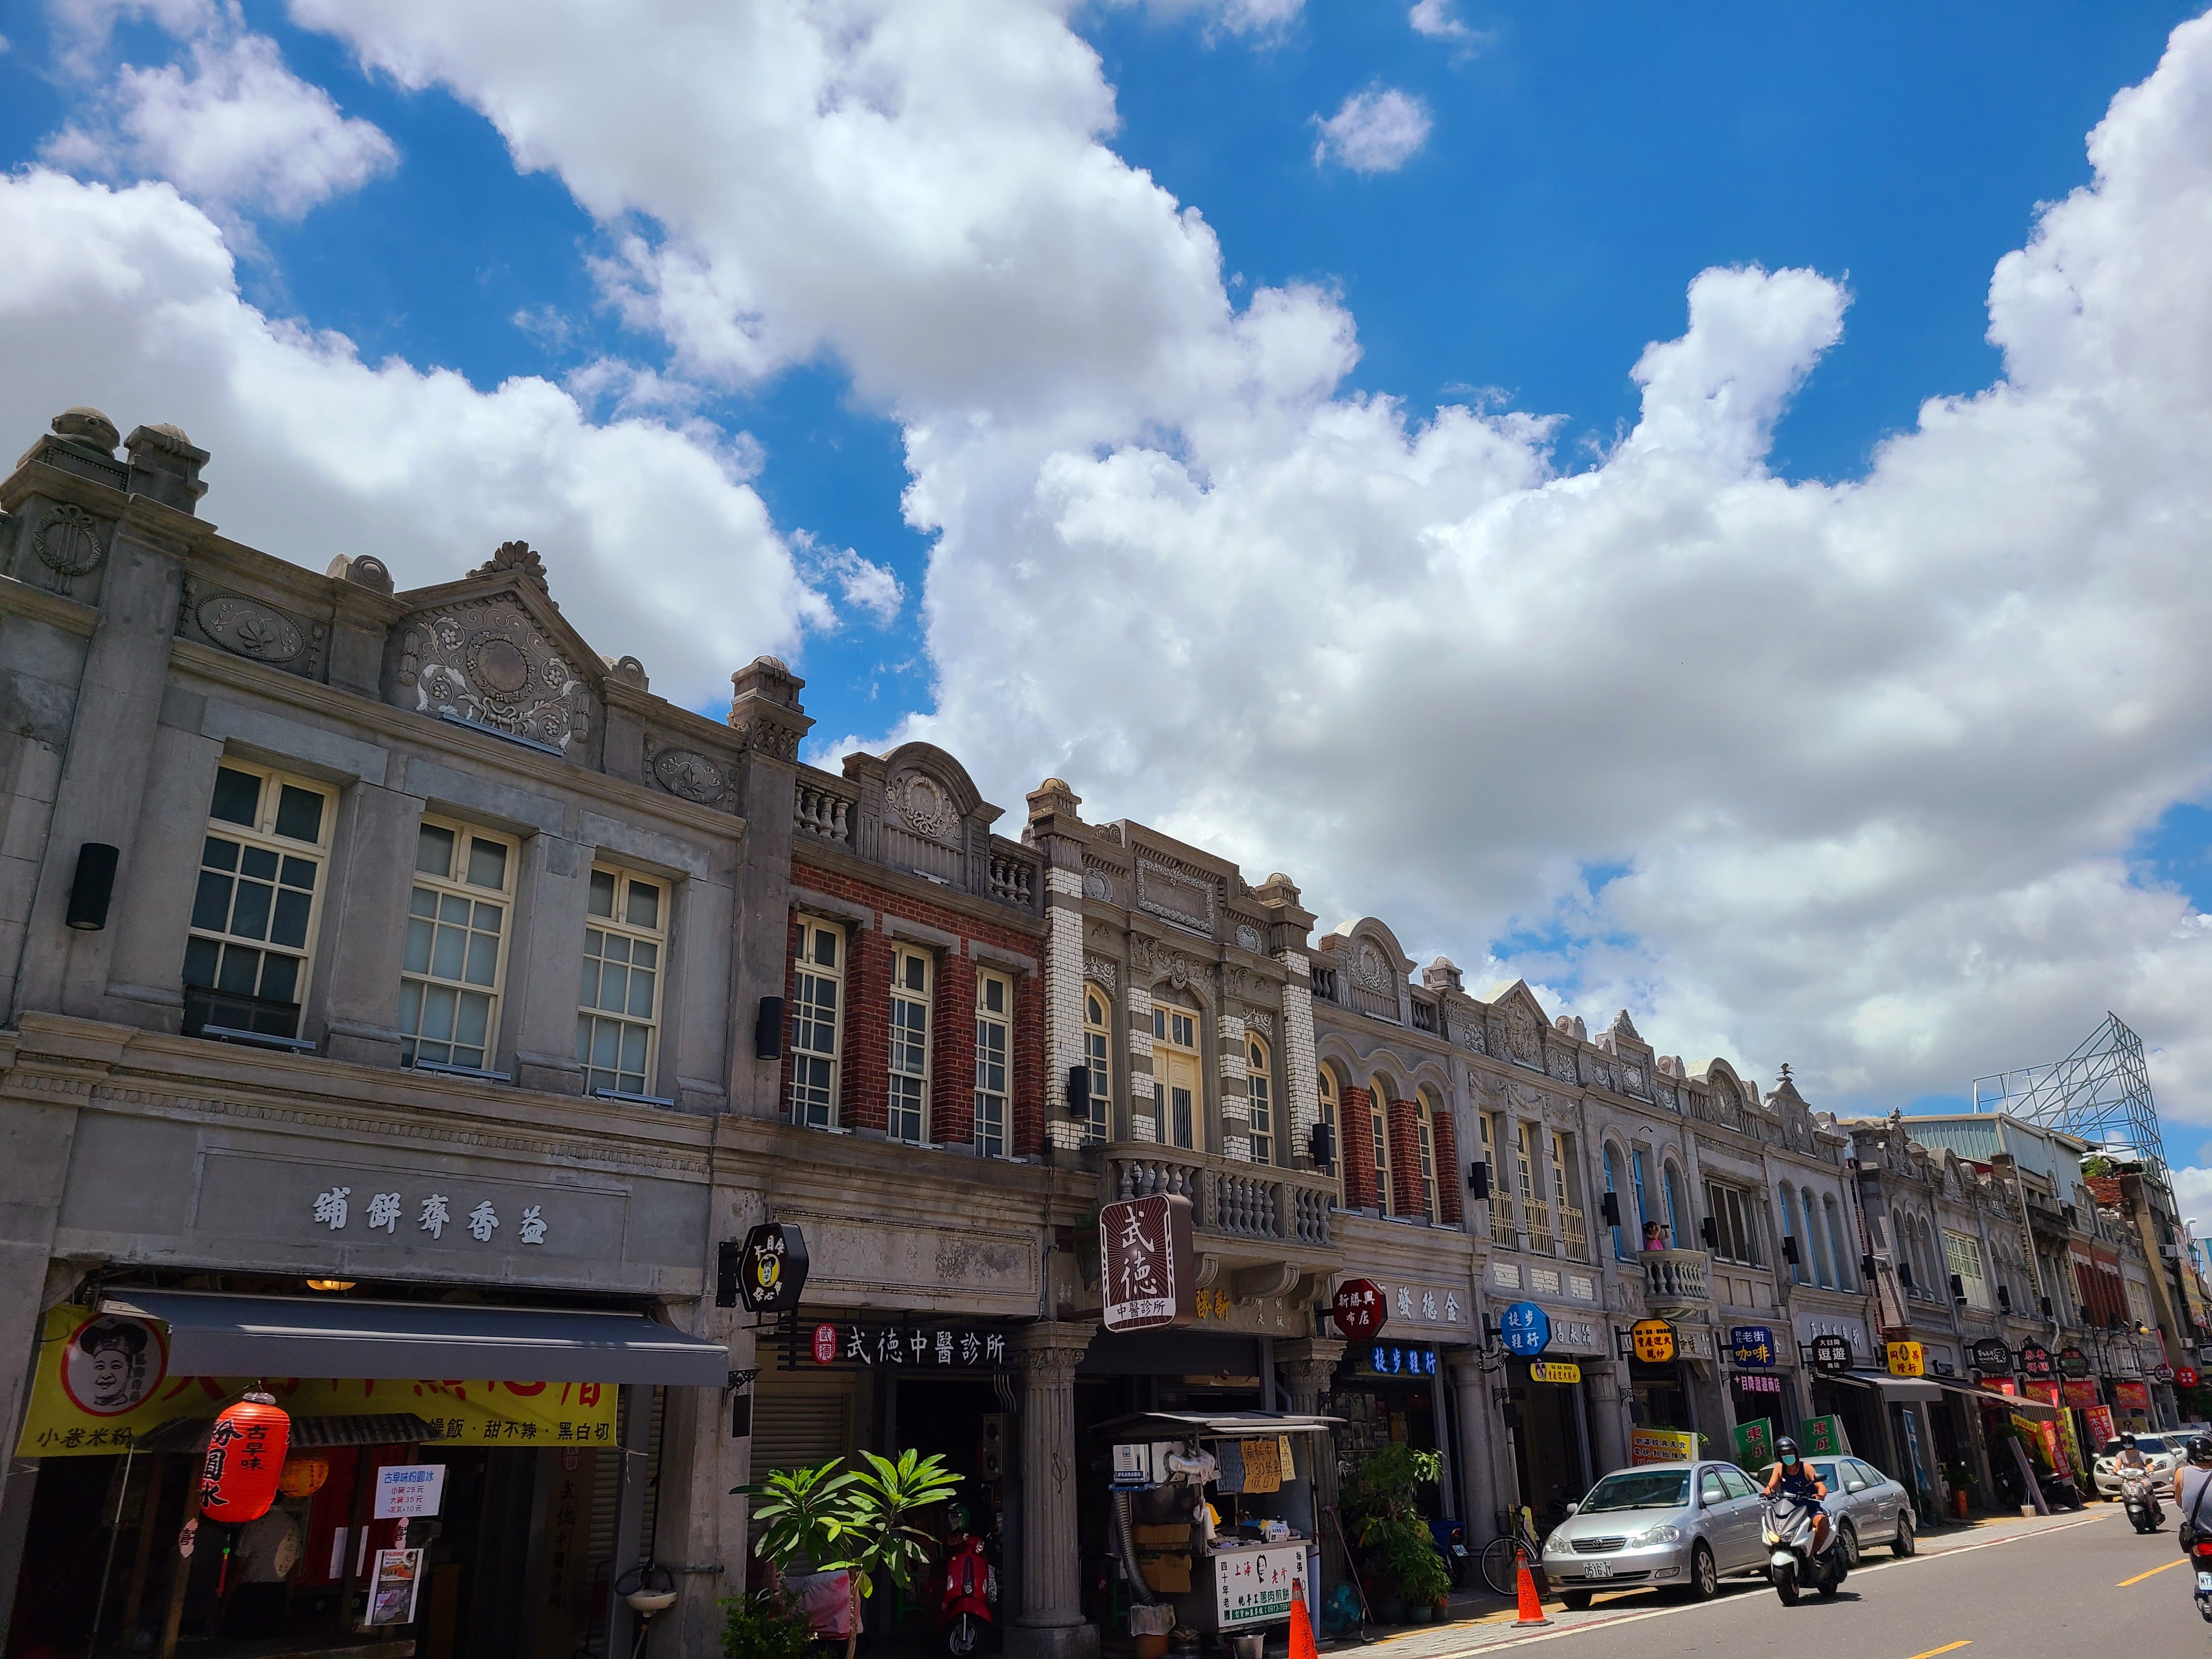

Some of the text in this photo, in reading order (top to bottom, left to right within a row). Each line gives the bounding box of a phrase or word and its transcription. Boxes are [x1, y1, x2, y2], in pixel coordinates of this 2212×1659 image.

[1120, 1205, 1158, 1300] 武德
[1338, 1290, 1375, 1308] 新勝興
[1117, 1300, 1165, 1319] 中醫診所
[1346, 1310, 1369, 1326] 布店
[1508, 1310, 1533, 1327] 捷步
[819, 1326, 832, 1360] 武德
[847, 1325, 1006, 1365] 武德中醫診所
[1511, 1332, 1539, 1348] 鞋行
[1742, 1331, 1764, 1342] 老街
[1374, 1347, 1436, 1374] 捷步鞋行
[1735, 1344, 1770, 1363] 咖啡
[1818, 1347, 1847, 1361] 逗遊
[37, 1427, 133, 1448] 小卷米粉
[484, 1420, 537, 1439] 甜不辣
[557, 1421, 609, 1440] 黑白切
[2090, 1418, 2108, 1448] 木瓜牛
[241, 1424, 269, 1471] 古早味
[1244, 1444, 1272, 1461] 備料中
[1296, 1550, 1303, 1572] 每張
[1235, 1561, 1288, 1584] 上海 老爹
